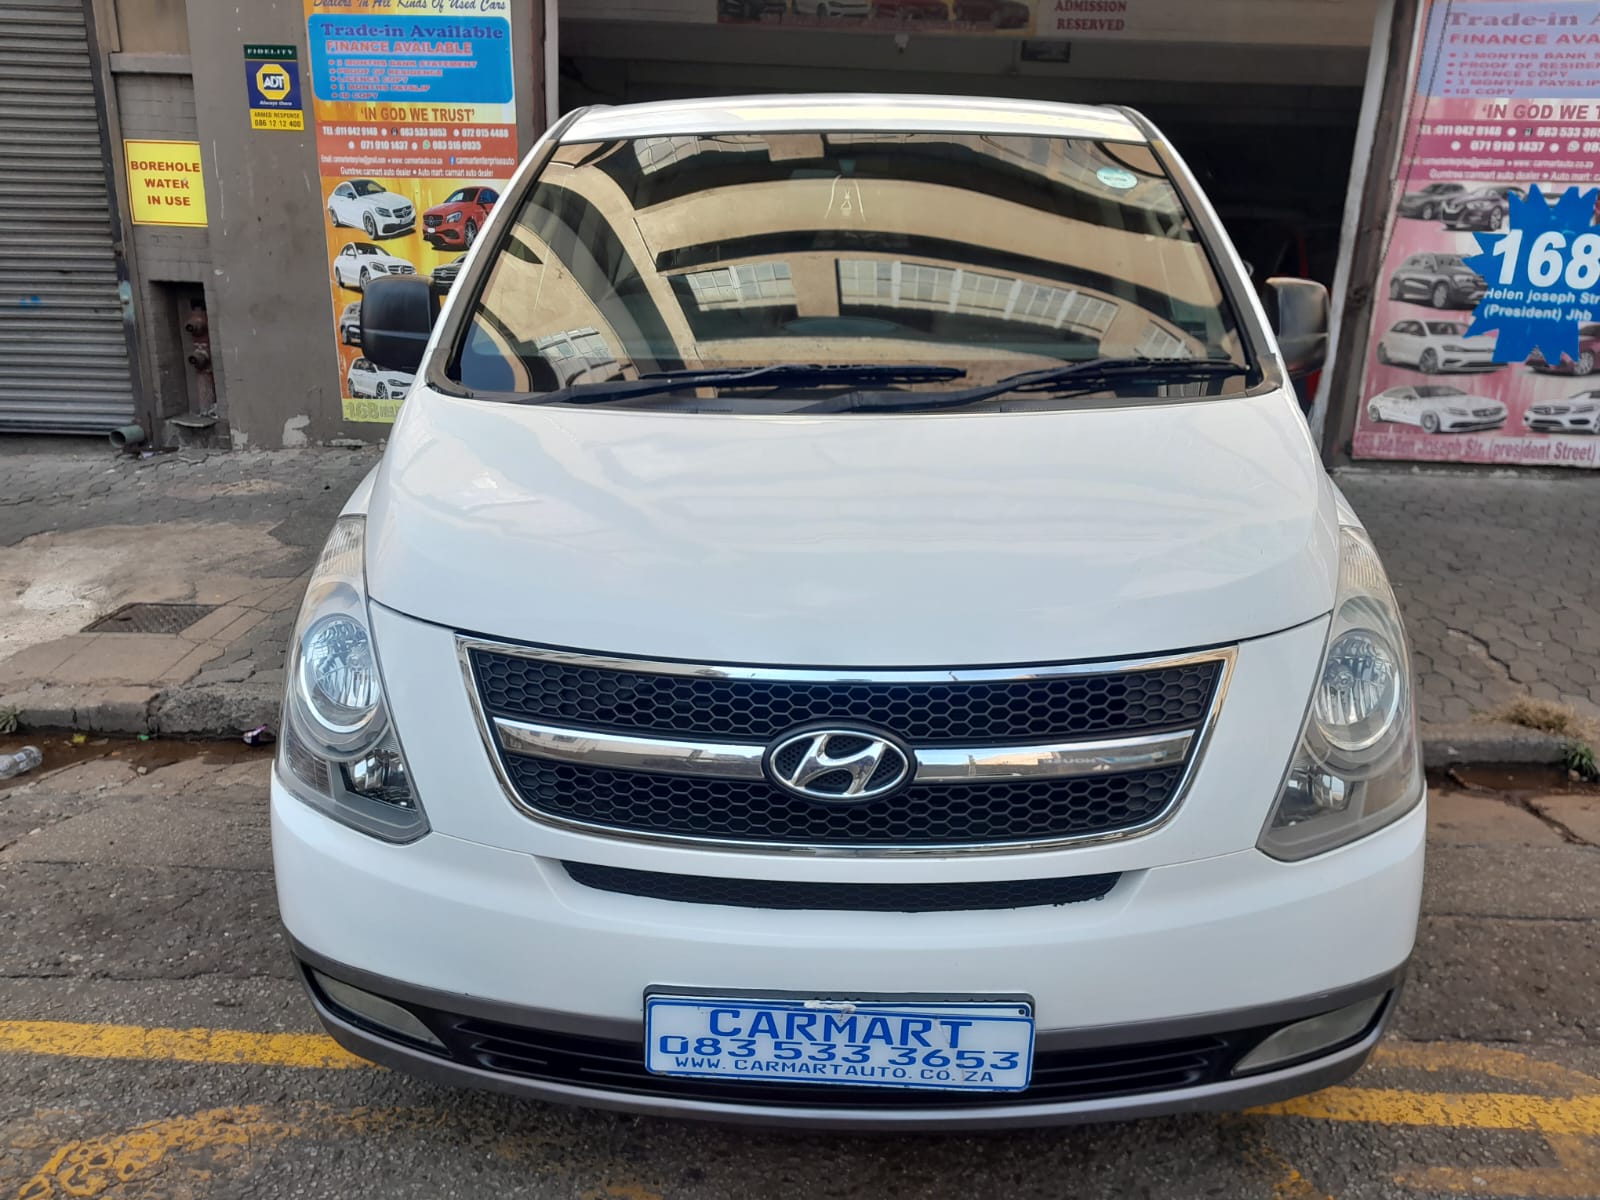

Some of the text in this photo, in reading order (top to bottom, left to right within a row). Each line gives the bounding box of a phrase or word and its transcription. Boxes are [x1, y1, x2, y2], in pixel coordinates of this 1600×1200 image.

[432, 0, 444, 13] Of
[450, 0, 476, 10] Used
[480, 0, 506, 12] Cars
[1055, 0, 1127, 12] ADMISSION
[1057, 18, 1125, 31] RESERVED
[1450, 12, 1578, 26] Trade-in
[321, 23, 503, 39] Trade-in Available
[1450, 34, 1548, 45] FINANCE
[326, 40, 472, 55] FINANCE AVAILABLE
[1475, 52, 1539, 60] MONTHS
[1544, 52, 1587, 60] BANK
[263, 75, 284, 89] ADT
[1470, 79, 1534, 87] MONTHS
[380, 108, 407, 121] GOD
[410, 108, 429, 121] WE
[1513, 104, 1553, 119] GOD
[1559, 105, 1589, 120] WE
[279, 120, 287, 128] 12
[130, 160, 201, 173] BOREHOLE
[144, 178, 190, 190] WATER
[147, 195, 191, 207] IN USE
[1492, 228, 1600, 290] 168
[1484, 288, 1524, 300] Helen
[1526, 289, 1576, 304] joseph
[1484, 303, 1593, 322] (President) Jhb
[1489, 439, 1551, 463] (president
[1553, 441, 1596, 463] Street)
[709, 1009, 973, 1049] CARMART
[659, 1035, 1020, 1070] 083 533 3653
